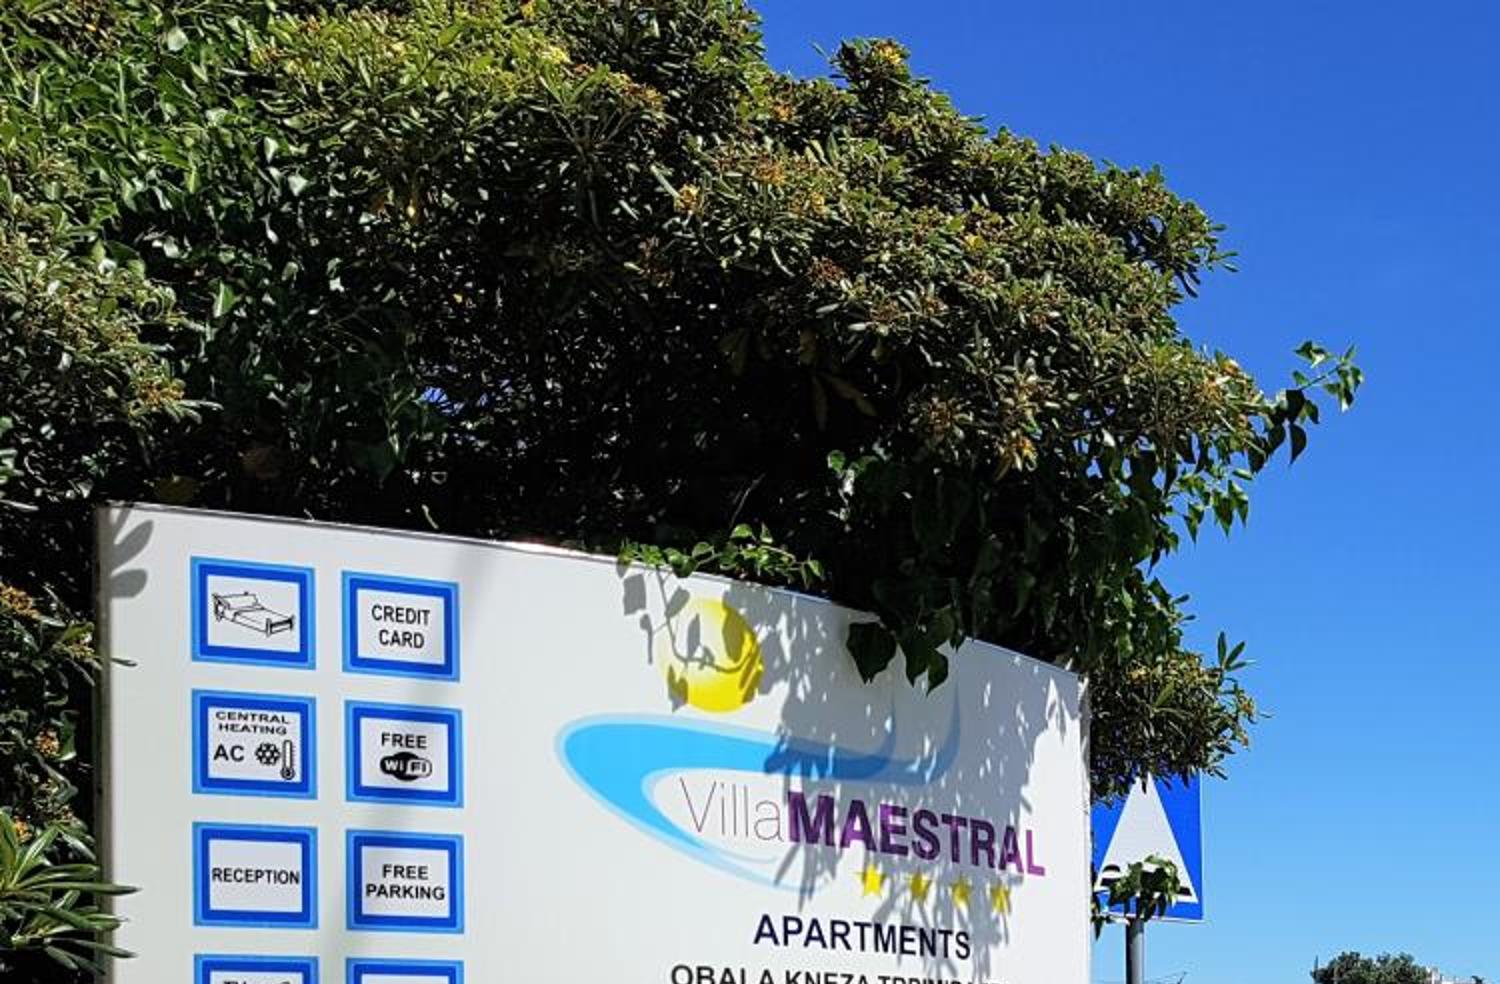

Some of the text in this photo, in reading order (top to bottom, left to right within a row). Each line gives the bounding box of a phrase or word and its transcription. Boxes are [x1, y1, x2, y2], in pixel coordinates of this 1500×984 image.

[371, 604, 431, 625] CREDIT
[378, 629, 424, 649] CARD
[215, 711, 290, 725] CENTRAL
[218, 723, 287, 736] HEATING
[381, 732, 427, 749] FREE
[213, 745, 245, 762] AC
[679, 776, 1046, 875] Villa MAESTRAL
[212, 867, 300, 885] RECEPTION
[382, 864, 428, 880] FREE
[365, 884, 445, 900] PARKING
[753, 914, 971, 959] APARTMENTS
